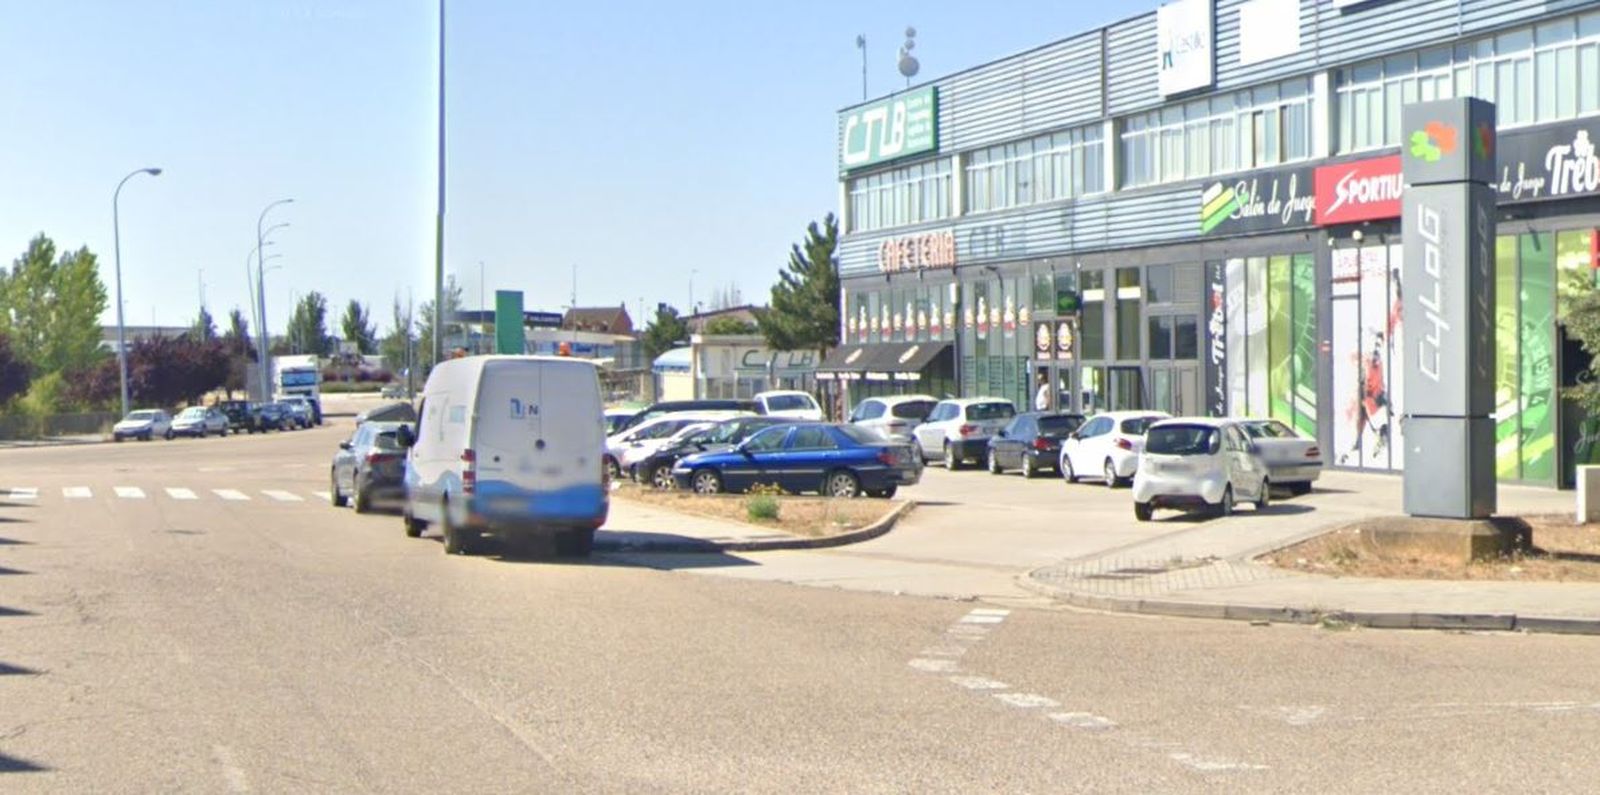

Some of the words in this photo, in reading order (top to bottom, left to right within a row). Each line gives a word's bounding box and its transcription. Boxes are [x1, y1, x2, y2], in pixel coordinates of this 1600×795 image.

[1324, 169, 1404, 217] SPORTIU
[1545, 144, 1600, 195] Treb
[878, 229, 955, 272] CAFETERIA
